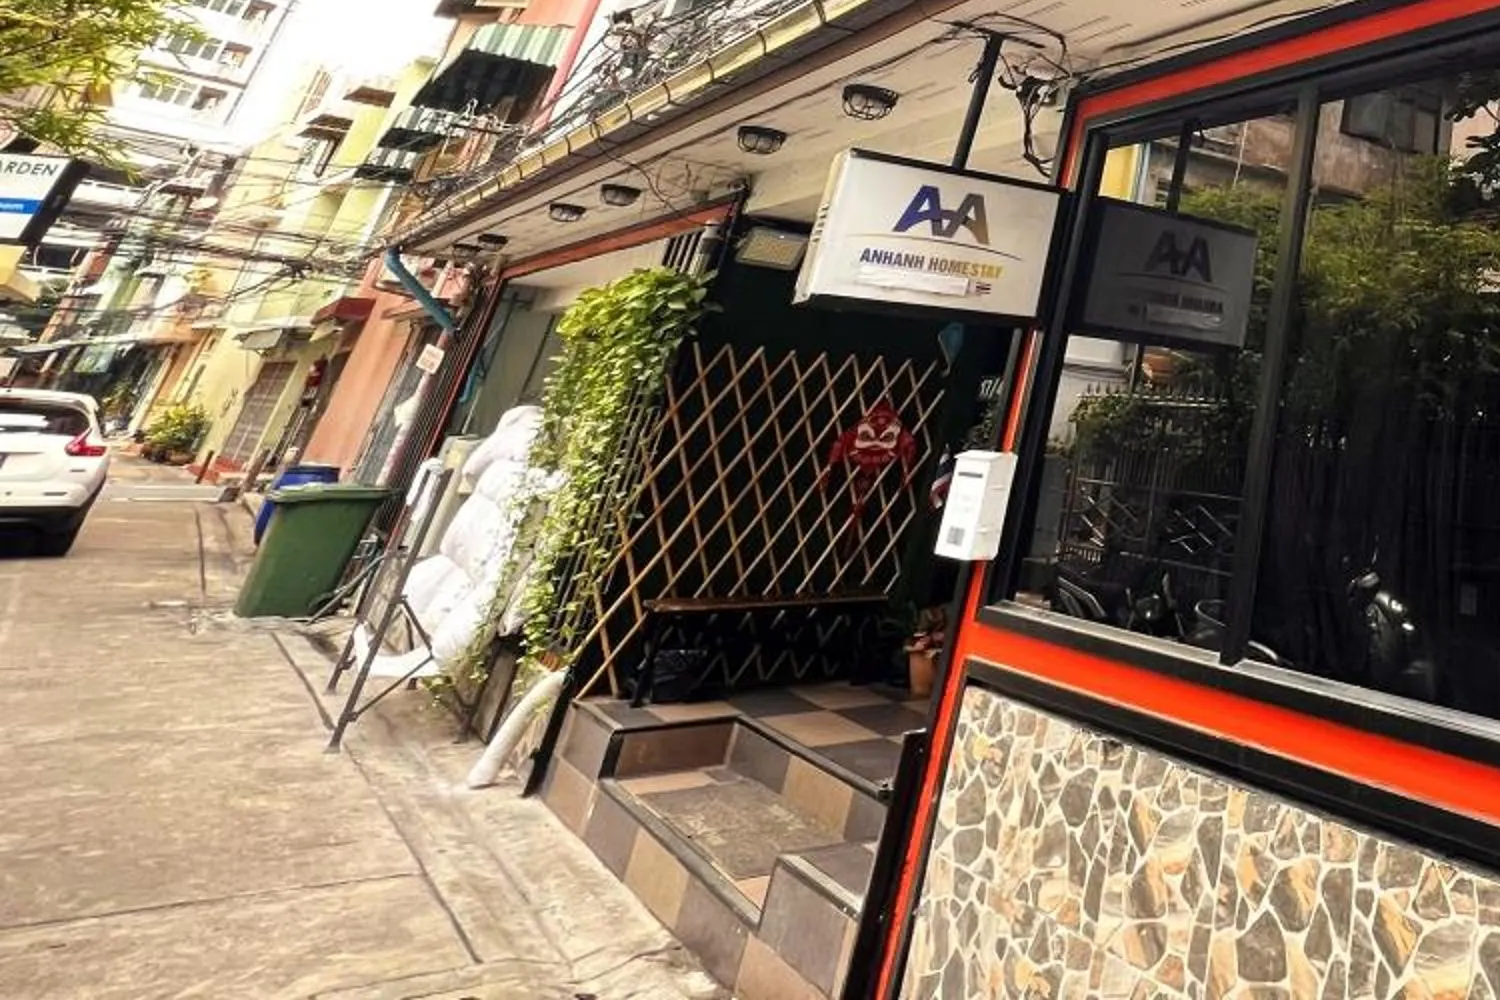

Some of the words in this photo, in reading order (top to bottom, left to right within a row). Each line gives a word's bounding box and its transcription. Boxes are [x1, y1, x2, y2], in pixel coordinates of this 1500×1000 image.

[0, 161, 59, 176] RDEN
[859, 248, 925, 269] ANHANH
[927, 257, 1004, 279] HOMESTAY
